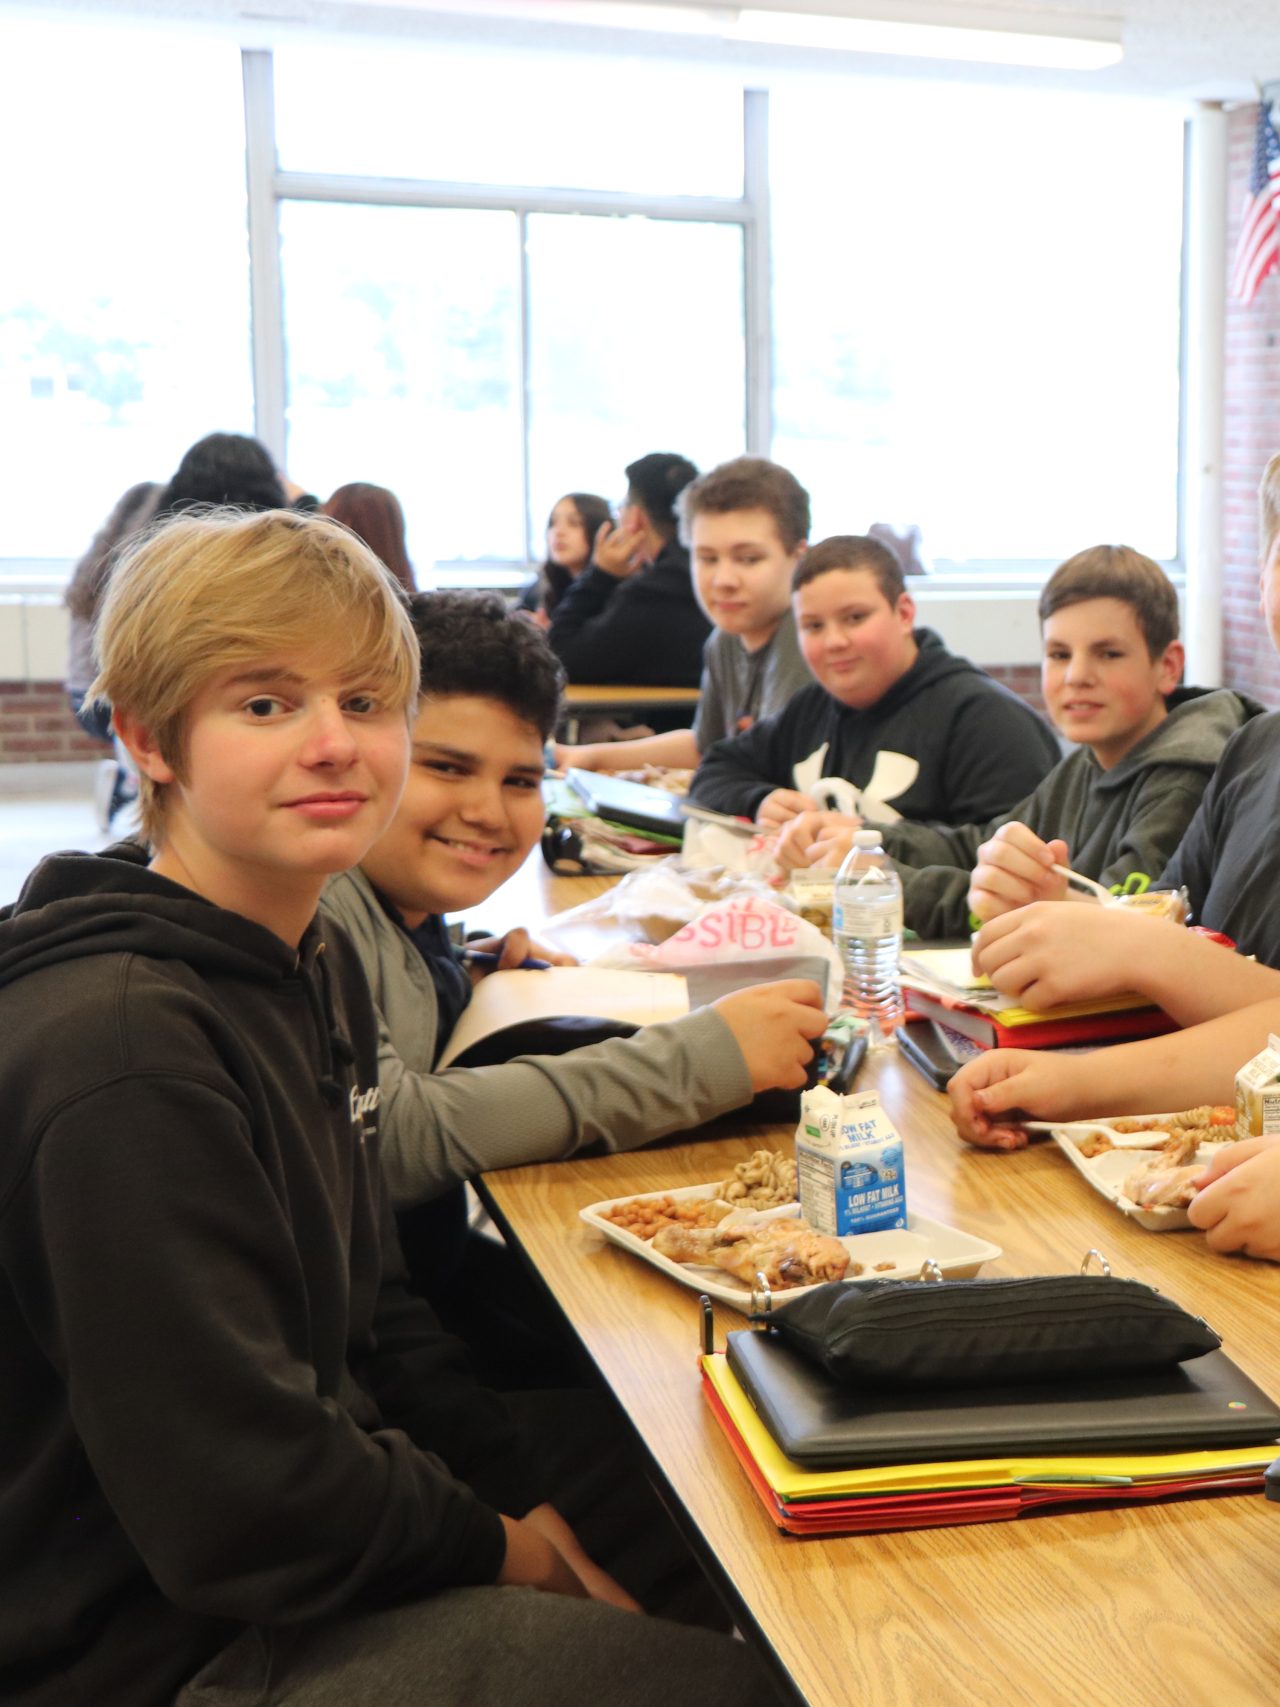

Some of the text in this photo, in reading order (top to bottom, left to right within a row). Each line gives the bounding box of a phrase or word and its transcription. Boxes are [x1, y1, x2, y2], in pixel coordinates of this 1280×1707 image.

[847, 1130, 876, 1143] MILK
[848, 1192, 866, 1208] LOW
[866, 1189, 881, 1204] FAT
[881, 1183, 900, 1200] MILK
